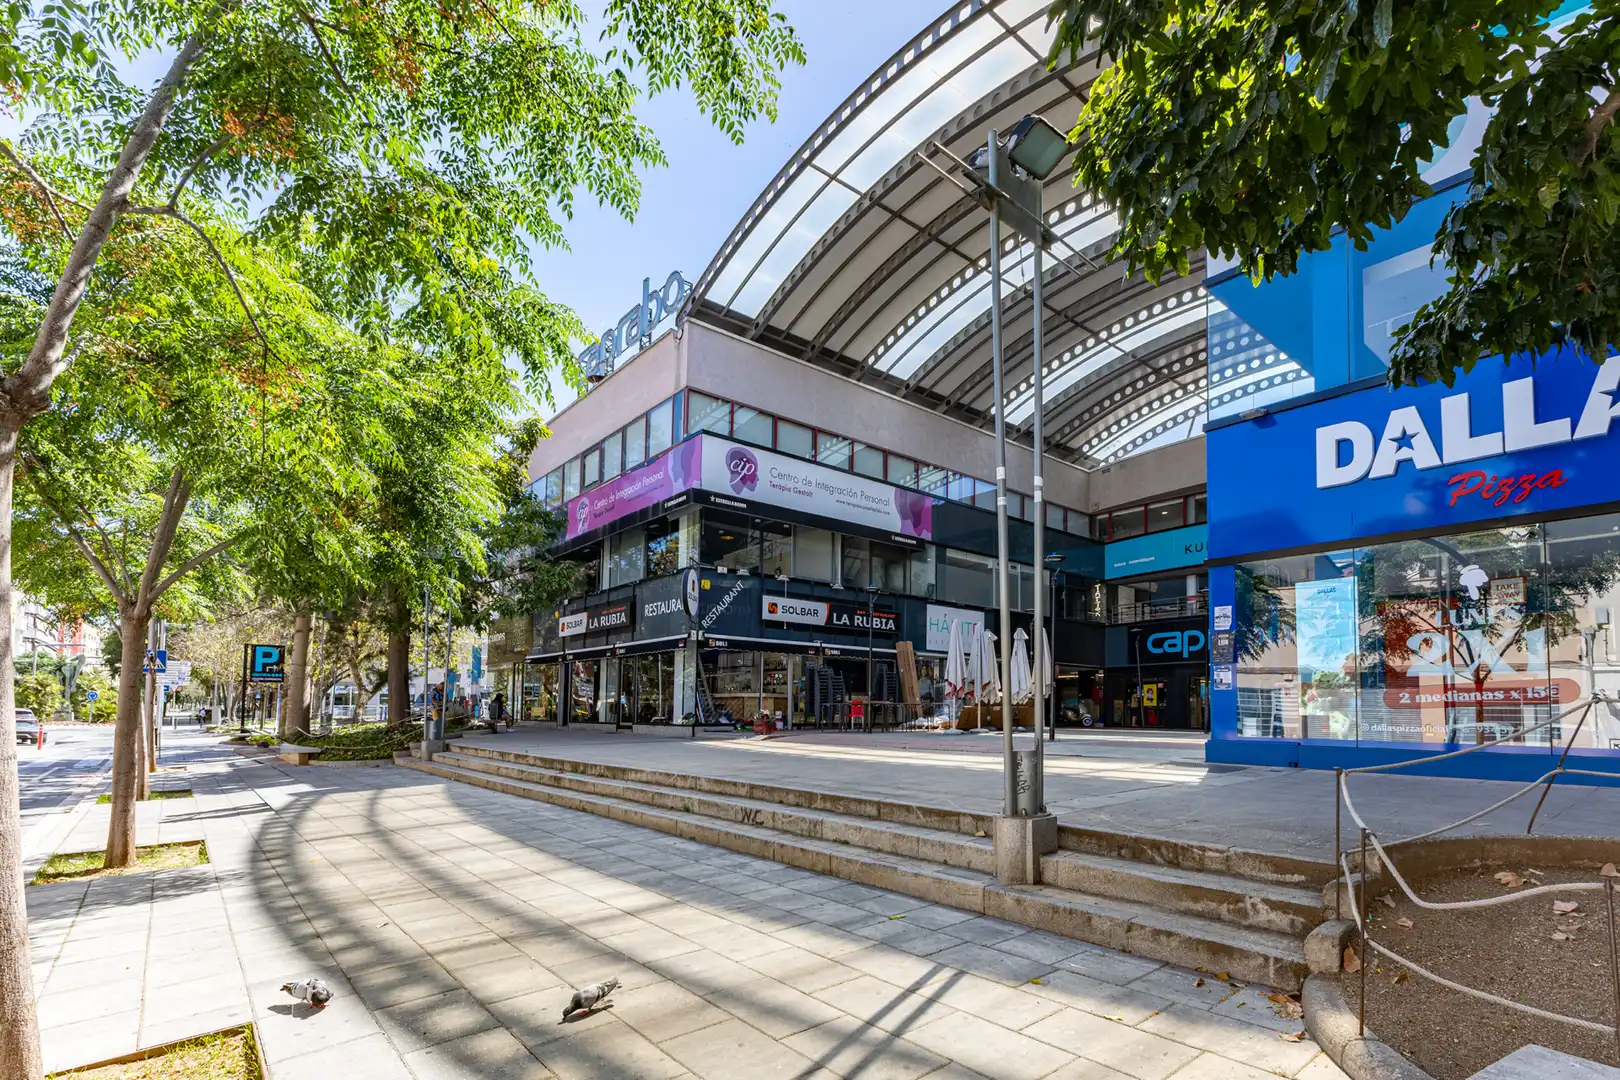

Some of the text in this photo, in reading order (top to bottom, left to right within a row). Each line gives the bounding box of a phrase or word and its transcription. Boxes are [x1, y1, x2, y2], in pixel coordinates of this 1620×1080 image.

[730, 457, 755, 485] cip
[594, 499, 608, 510] Centro
[608, 494, 615, 504] de
[615, 481, 642, 500] Integración
[642, 466, 664, 488] Personal
[769, 467, 890, 507] Centro de Integración Personal
[793, 487, 813, 498] Gestalt
[1447, 468, 1568, 507] Pizza
[1185, 541, 1208, 554] KU
[1496, 583, 1520, 591] TAKE
[644, 598, 684, 617] RESTAURA
[701, 580, 745, 629] RESTAURANT
[781, 605, 819, 618] SOLBAR
[566, 619, 583, 630] SOLBAR
[589, 612, 626, 629] LA RUBIA
[833, 613, 896, 631] LA RUBIA
[929, 612, 978, 636] HÁIT
[255, 646, 279, 672] P
[1399, 684, 1560, 704] 2 medianas x 15€
[1370, 723, 1449, 734] dallaspizzaoficial
